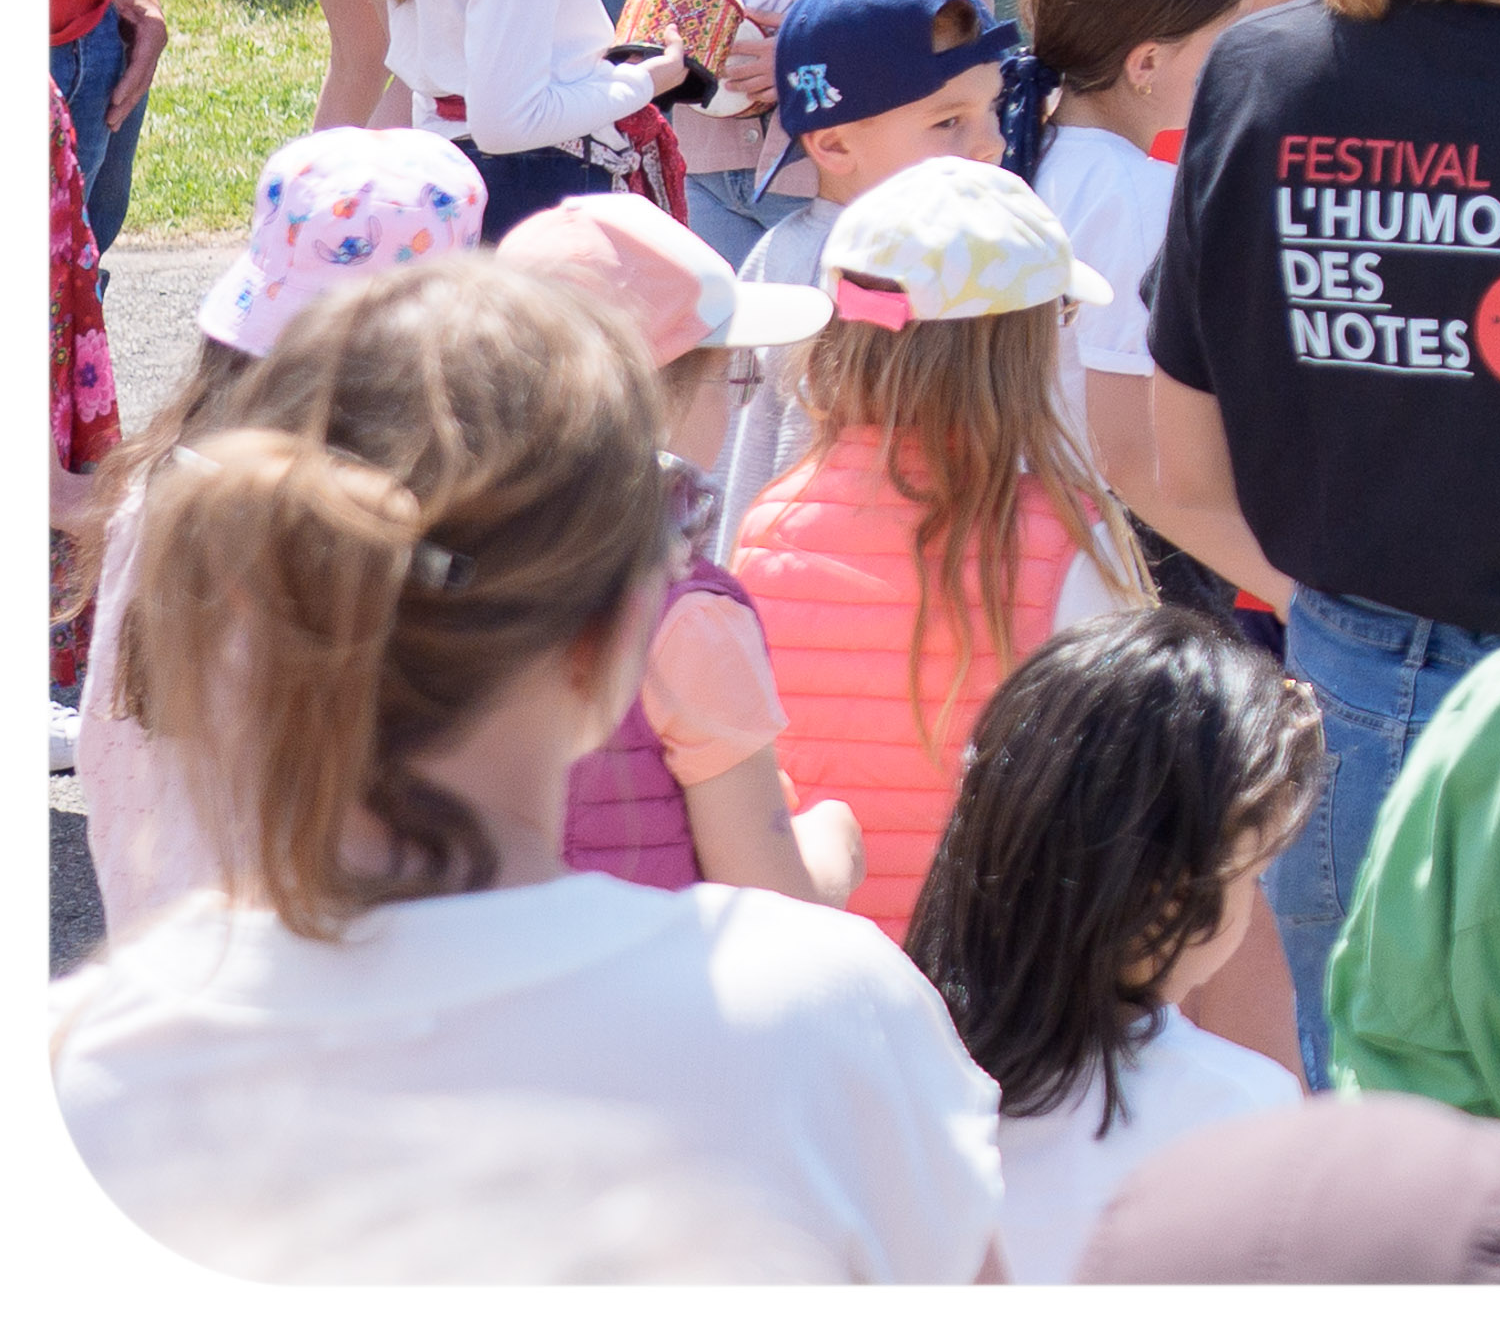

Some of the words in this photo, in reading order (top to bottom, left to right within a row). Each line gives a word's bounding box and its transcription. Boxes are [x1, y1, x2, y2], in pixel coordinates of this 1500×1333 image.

[1277, 135, 1491, 190] FESTIVAL
[1281, 248, 1384, 303] DES
[1290, 308, 1471, 370] NOTES
